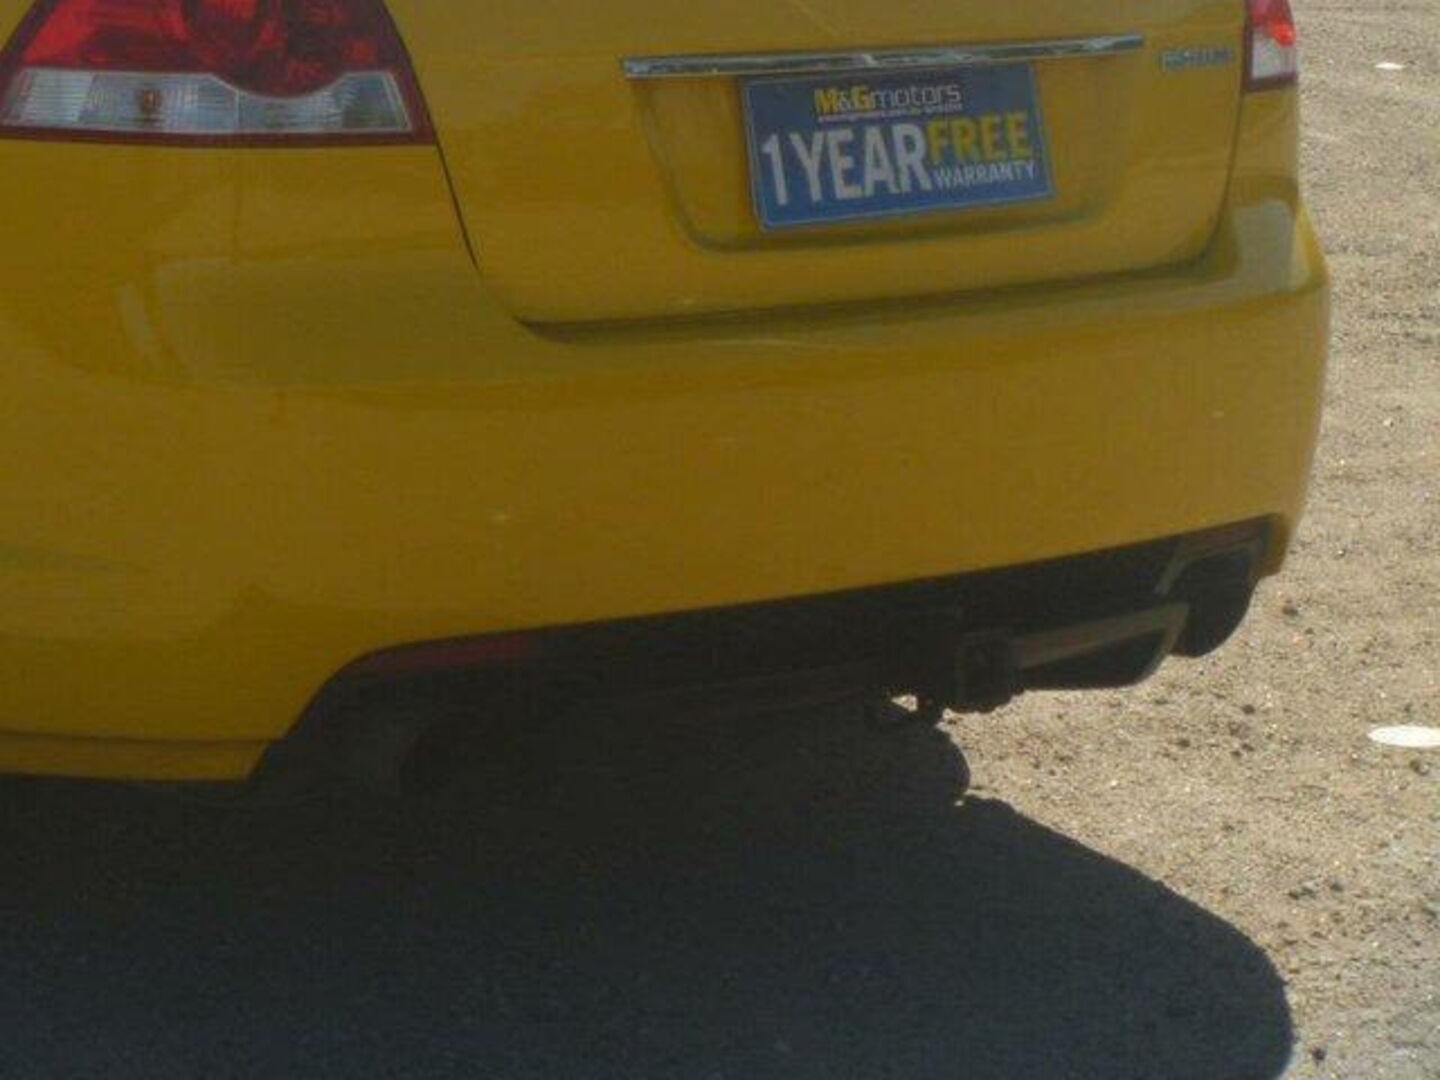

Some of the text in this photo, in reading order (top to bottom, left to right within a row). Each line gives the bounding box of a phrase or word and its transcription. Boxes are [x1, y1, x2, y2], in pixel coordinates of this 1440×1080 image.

[763, 111, 1032, 206] 1 YEAR FREE
[934, 160, 1036, 190] WARRANTY
